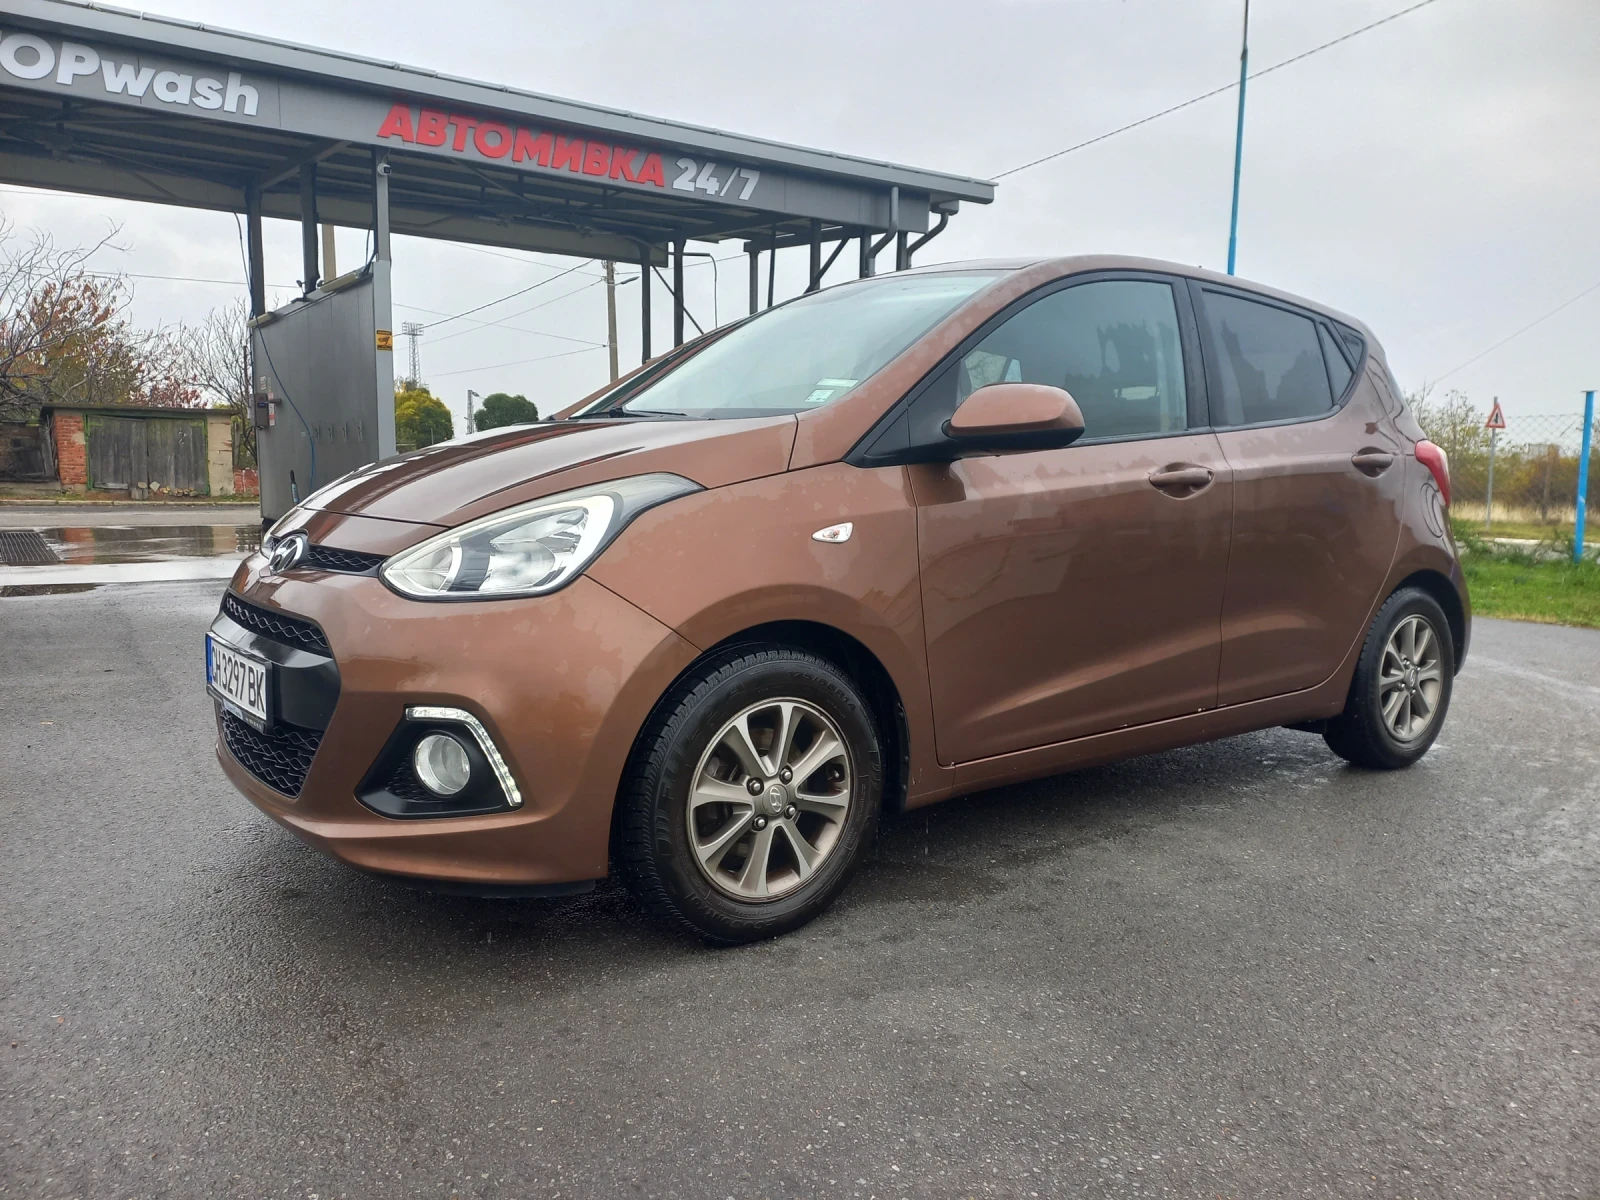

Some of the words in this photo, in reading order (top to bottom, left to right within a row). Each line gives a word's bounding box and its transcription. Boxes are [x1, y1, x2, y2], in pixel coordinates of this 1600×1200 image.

[0, 30, 260, 116] OPwash
[377, 103, 665, 188] АВТОМИВКА
[672, 157, 760, 201] 24/7
[222, 652, 246, 701] 3297
[248, 665, 266, 713] BK
